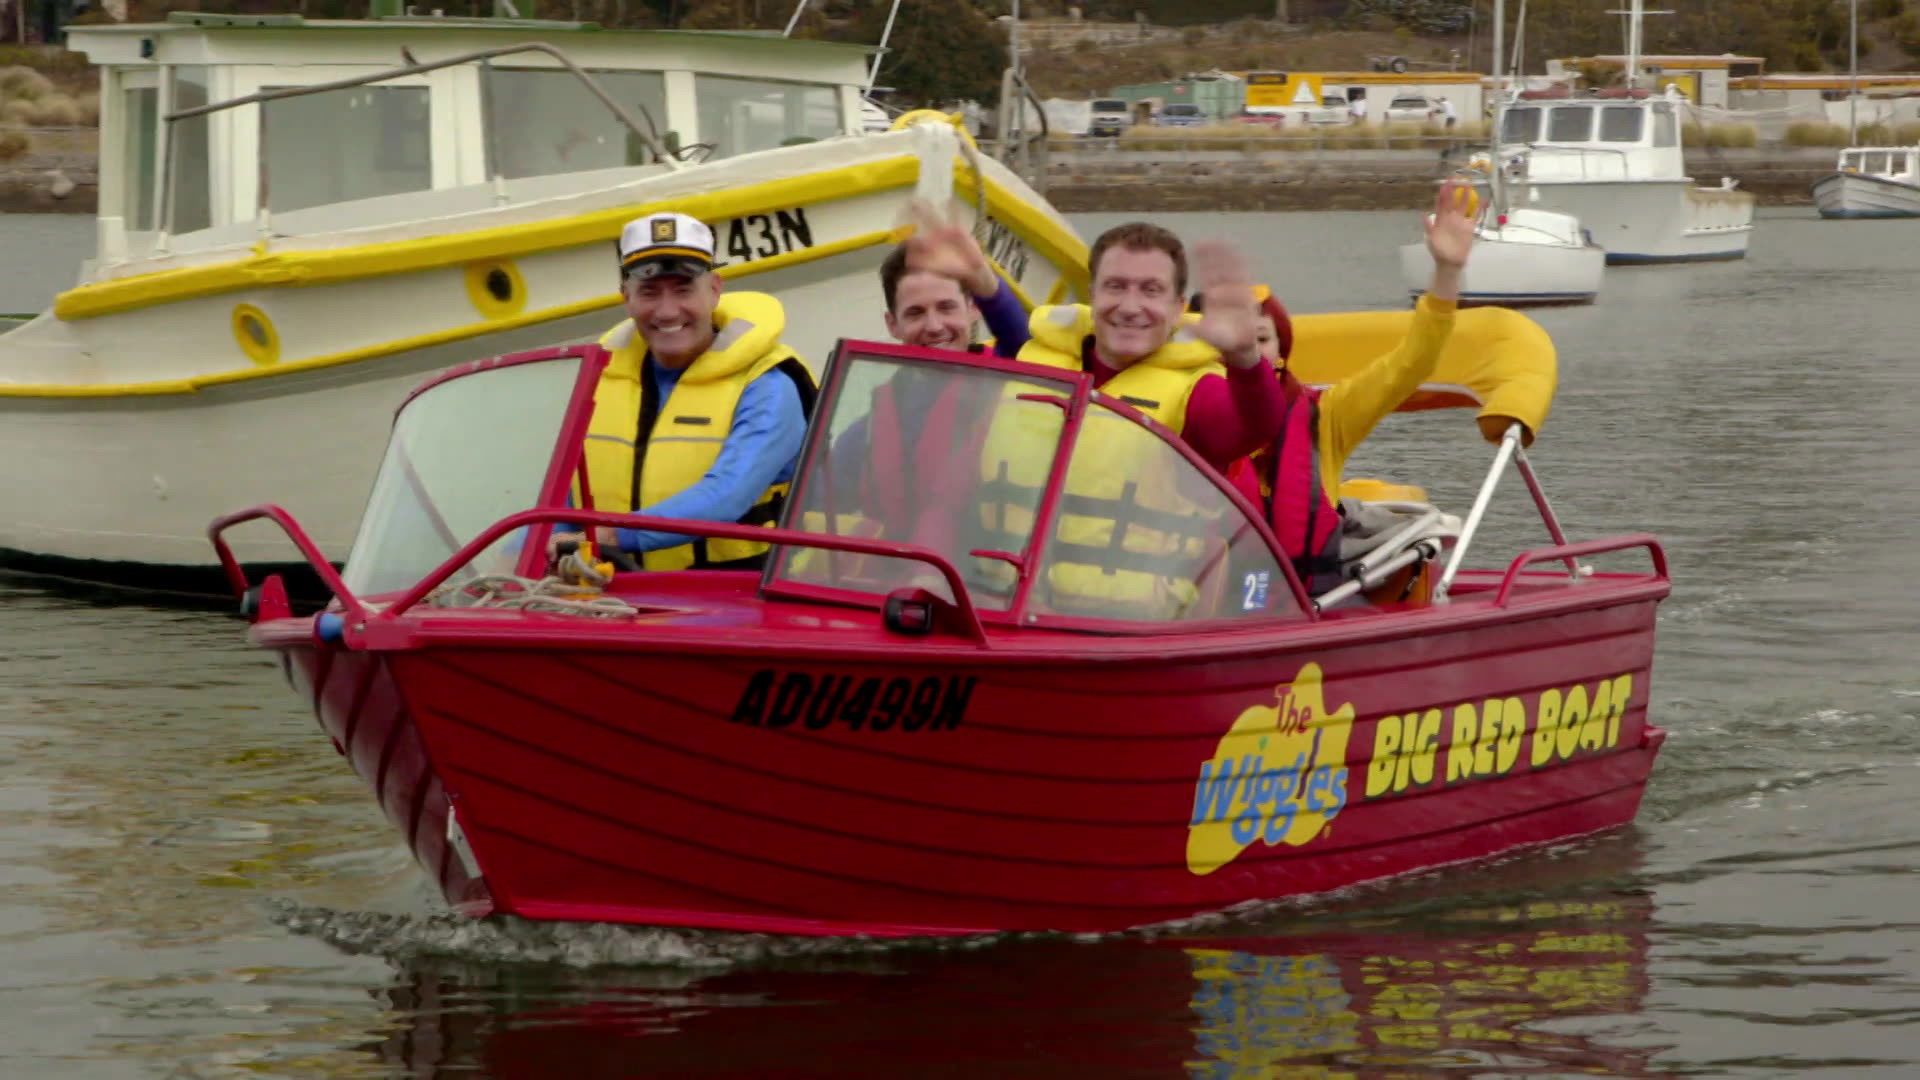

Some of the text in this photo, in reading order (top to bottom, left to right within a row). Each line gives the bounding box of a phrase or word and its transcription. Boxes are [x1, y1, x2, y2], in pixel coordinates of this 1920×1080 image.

[731, 669, 979, 731] ADU499N
[1276, 684, 1312, 736] The
[1365, 673, 1632, 799] BIG RED BOAT
[1191, 727, 1348, 845] Wiggles
